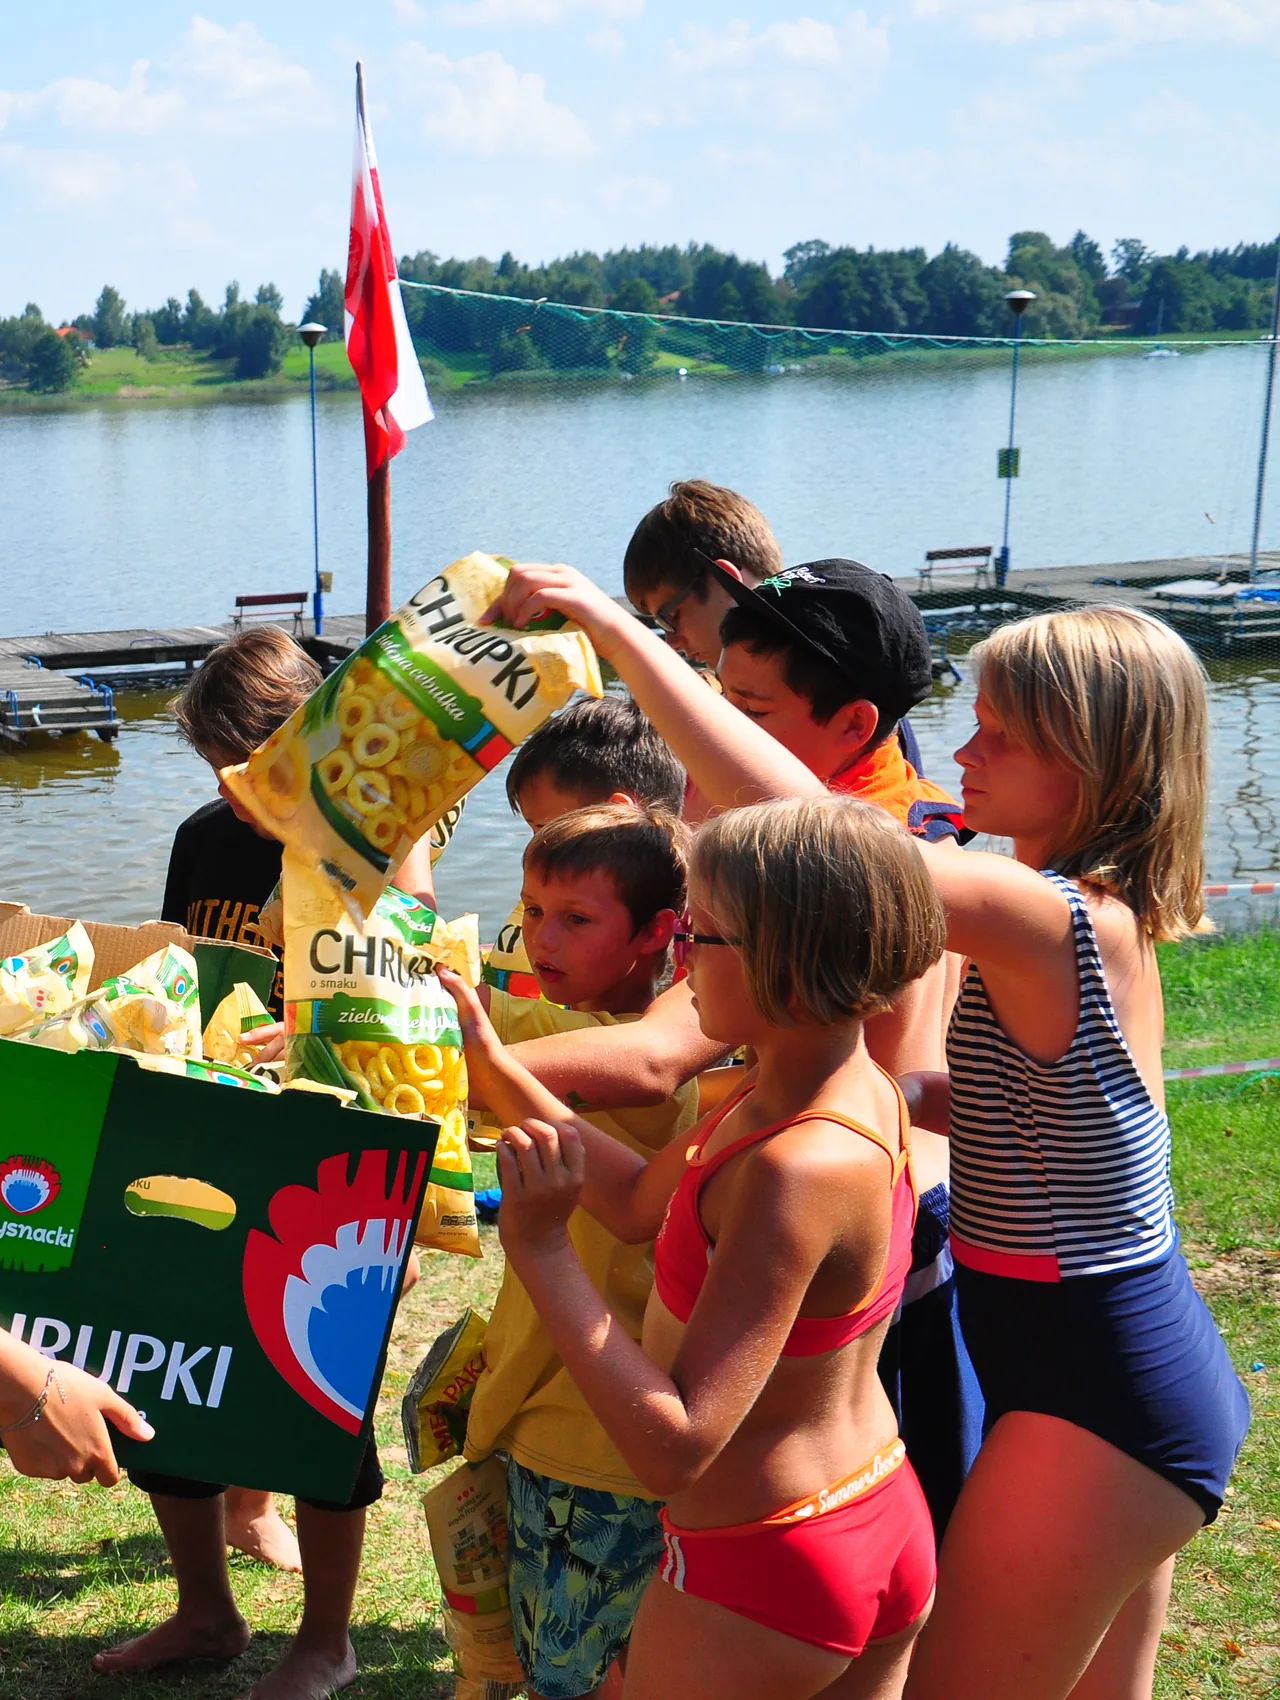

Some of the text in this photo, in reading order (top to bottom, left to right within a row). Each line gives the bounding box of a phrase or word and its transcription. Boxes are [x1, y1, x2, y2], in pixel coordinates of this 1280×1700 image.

[410, 576, 541, 711] CHRUPKI
[409, 664, 466, 722] cebulka
[311, 977, 357, 989] o smaku
